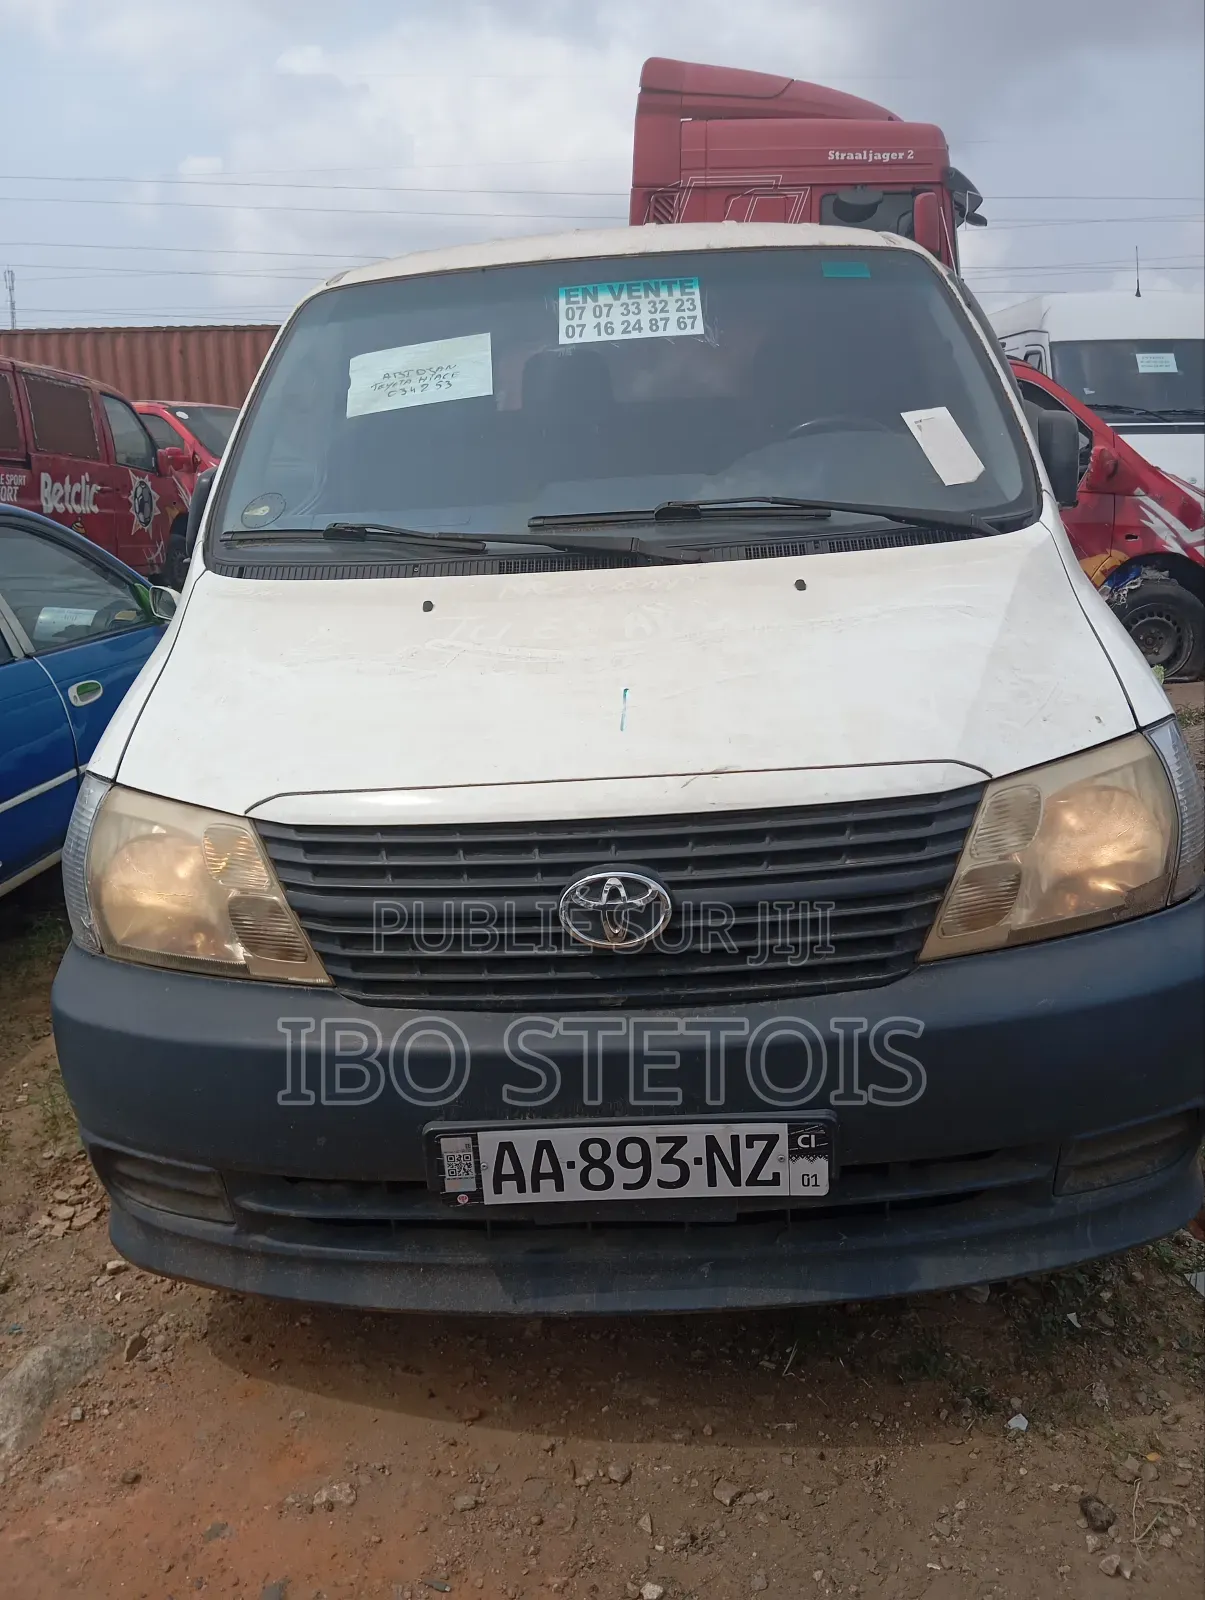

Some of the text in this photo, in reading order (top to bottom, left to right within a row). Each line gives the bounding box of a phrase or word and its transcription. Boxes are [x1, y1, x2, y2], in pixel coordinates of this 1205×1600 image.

[828, 149, 914, 162] Straaljager 2
[565, 279, 696, 305] EN VENTE
[565, 297, 697, 321] 07 07 33 32 23
[565, 315, 698, 339] 07 16 24 87 67
[0, 473, 26, 486] E SPORT
[0, 486, 19, 502] ORT
[40, 472, 100, 514] Betclic
[797, 1134, 816, 1148] CI
[801, 1173, 820, 1187] 01
